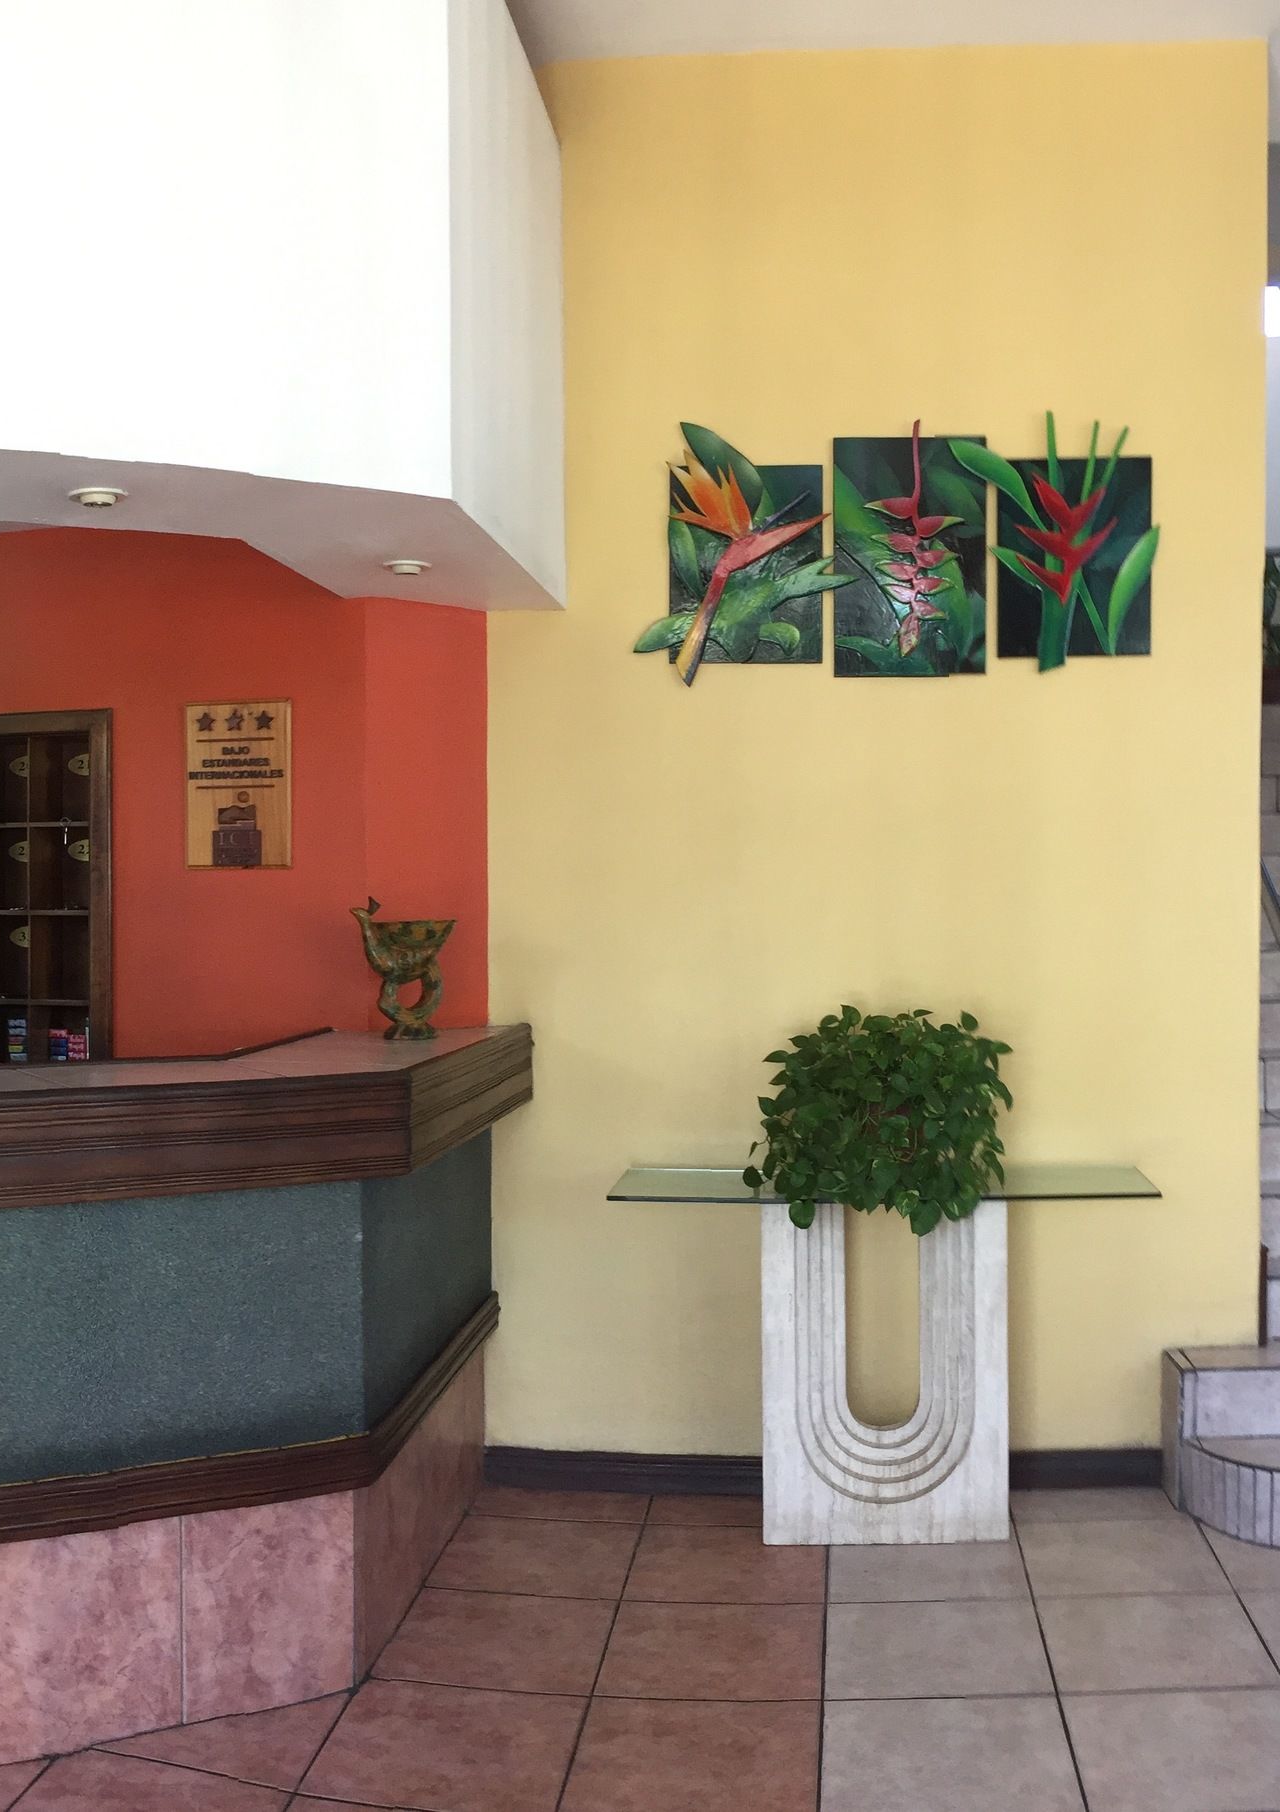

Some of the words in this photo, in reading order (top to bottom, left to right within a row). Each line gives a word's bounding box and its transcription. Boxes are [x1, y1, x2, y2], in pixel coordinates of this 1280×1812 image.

[221, 746, 250, 756] BAJO
[202, 758, 271, 768] ESTANDARES
[189, 769, 284, 780] INTERNACIONALES
